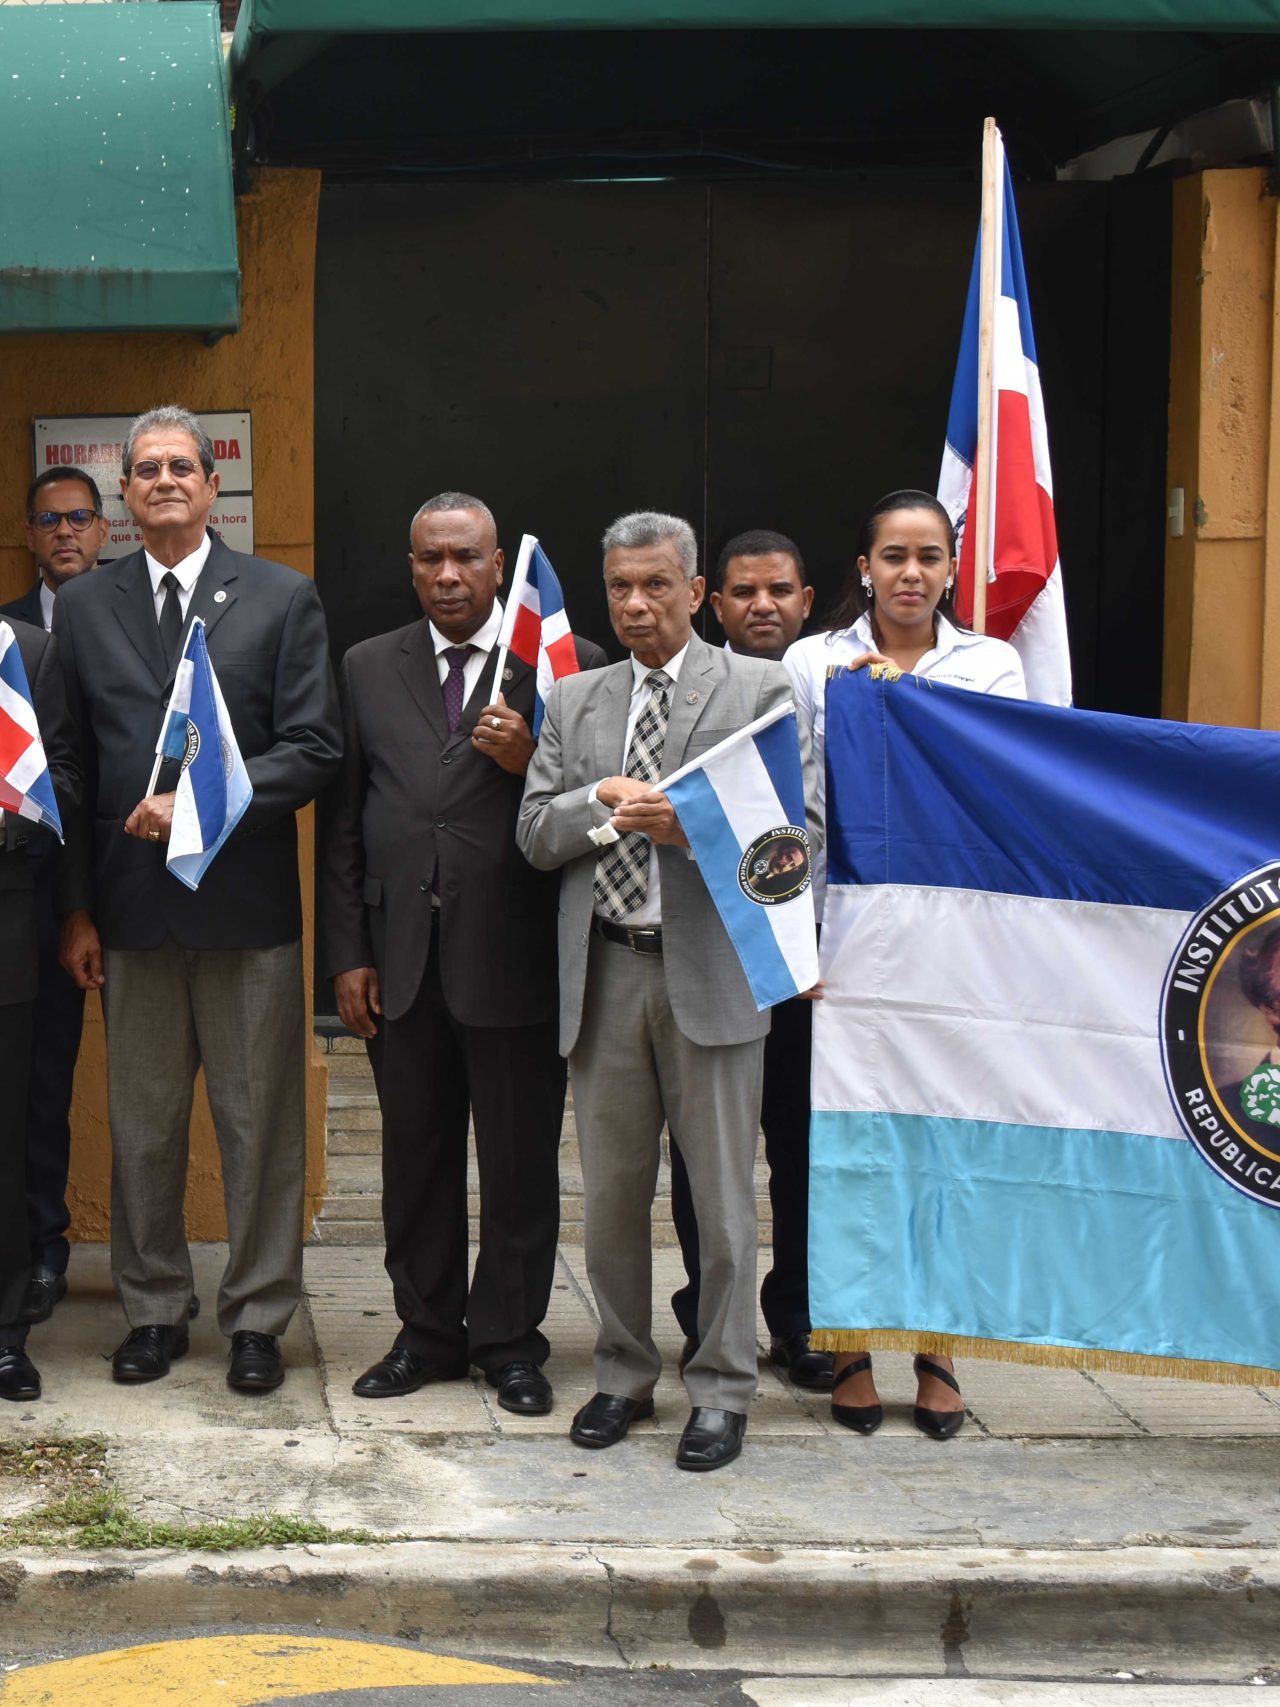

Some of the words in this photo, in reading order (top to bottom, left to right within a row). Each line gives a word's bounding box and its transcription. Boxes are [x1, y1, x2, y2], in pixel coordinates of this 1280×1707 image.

[45, 443, 122, 465] HORARI
[213, 438, 241, 460] DA
[108, 519, 129, 528] scar
[209, 514, 219, 524] la
[222, 514, 247, 524] hora
[111, 533, 131, 544] que
[1174, 877, 1280, 993] INSTITUT
